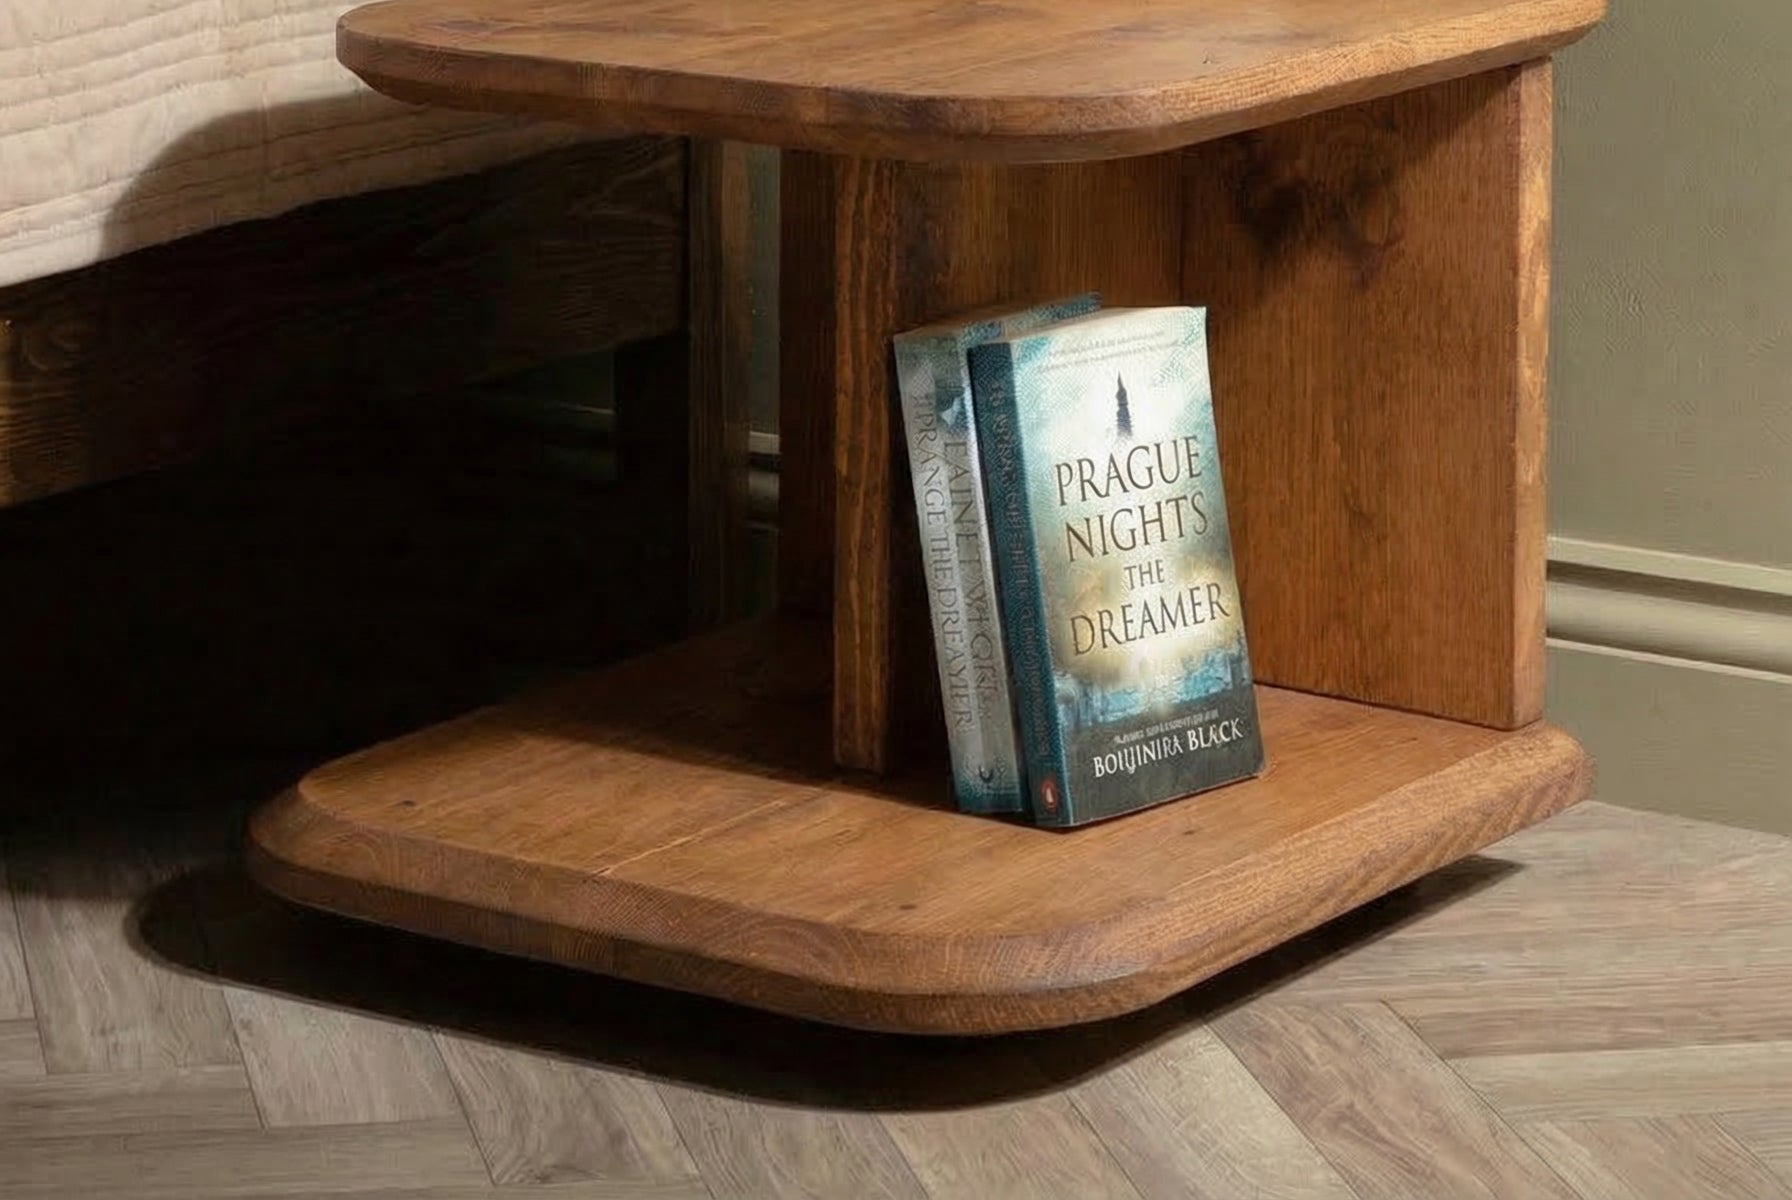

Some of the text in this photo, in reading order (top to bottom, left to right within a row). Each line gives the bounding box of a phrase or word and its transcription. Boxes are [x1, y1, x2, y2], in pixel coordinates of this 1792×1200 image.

[1054, 434, 1203, 507] PRAGUE
[930, 529, 954, 580] THE
[1065, 490, 1208, 563] NIGHTS
[1123, 558, 1166, 591] THE
[1069, 582, 1232, 657] DREAMER
[1186, 717, 1244, 751] BLACK
